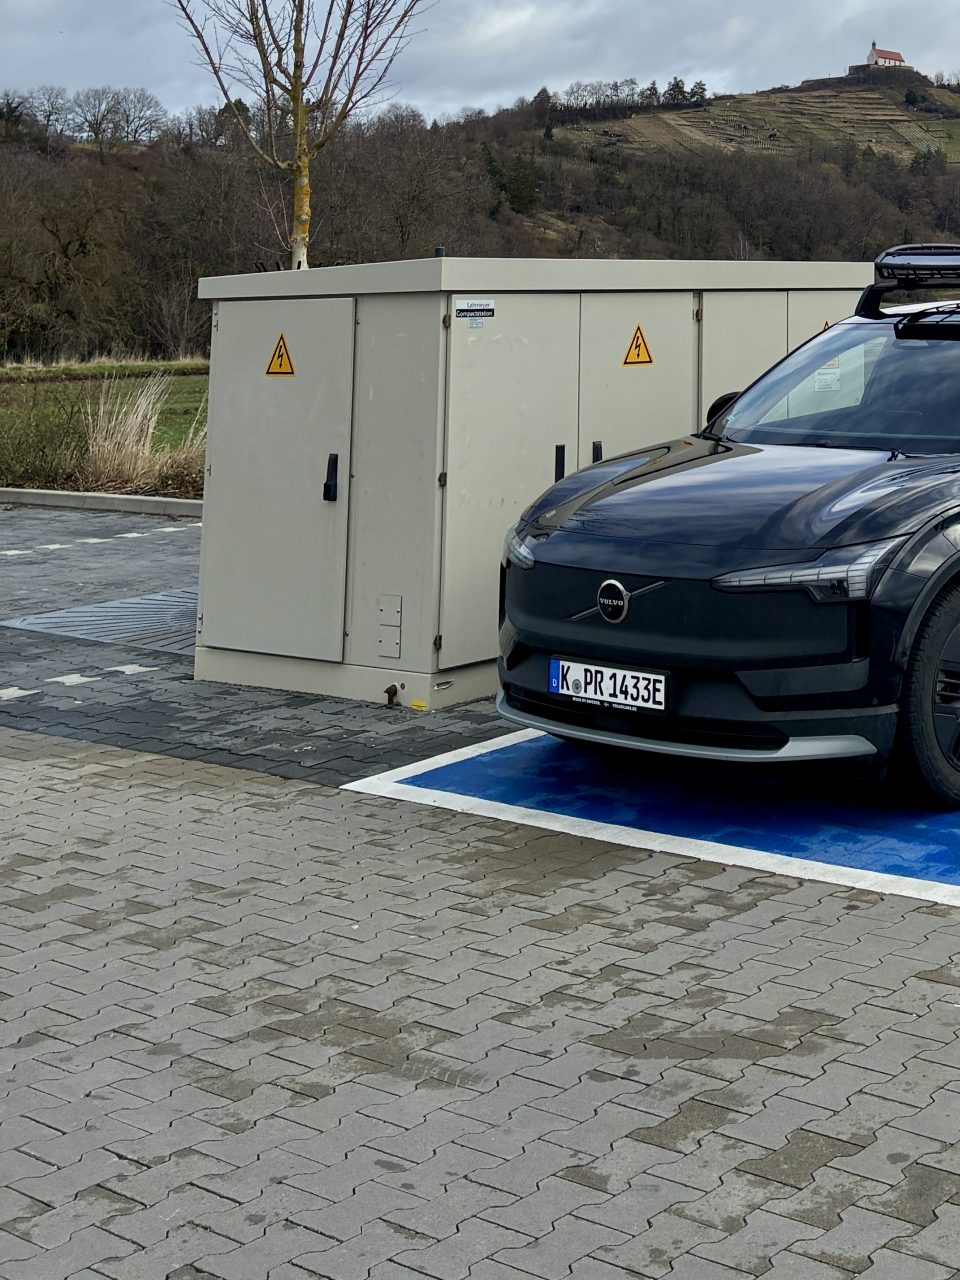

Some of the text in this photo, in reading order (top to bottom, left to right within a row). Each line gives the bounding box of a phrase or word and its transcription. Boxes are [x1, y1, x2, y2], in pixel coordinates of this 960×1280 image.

[600, 597, 623, 606] VOLVO
[553, 679, 557, 687] D
[560, 664, 663, 706] K PR 1433E
